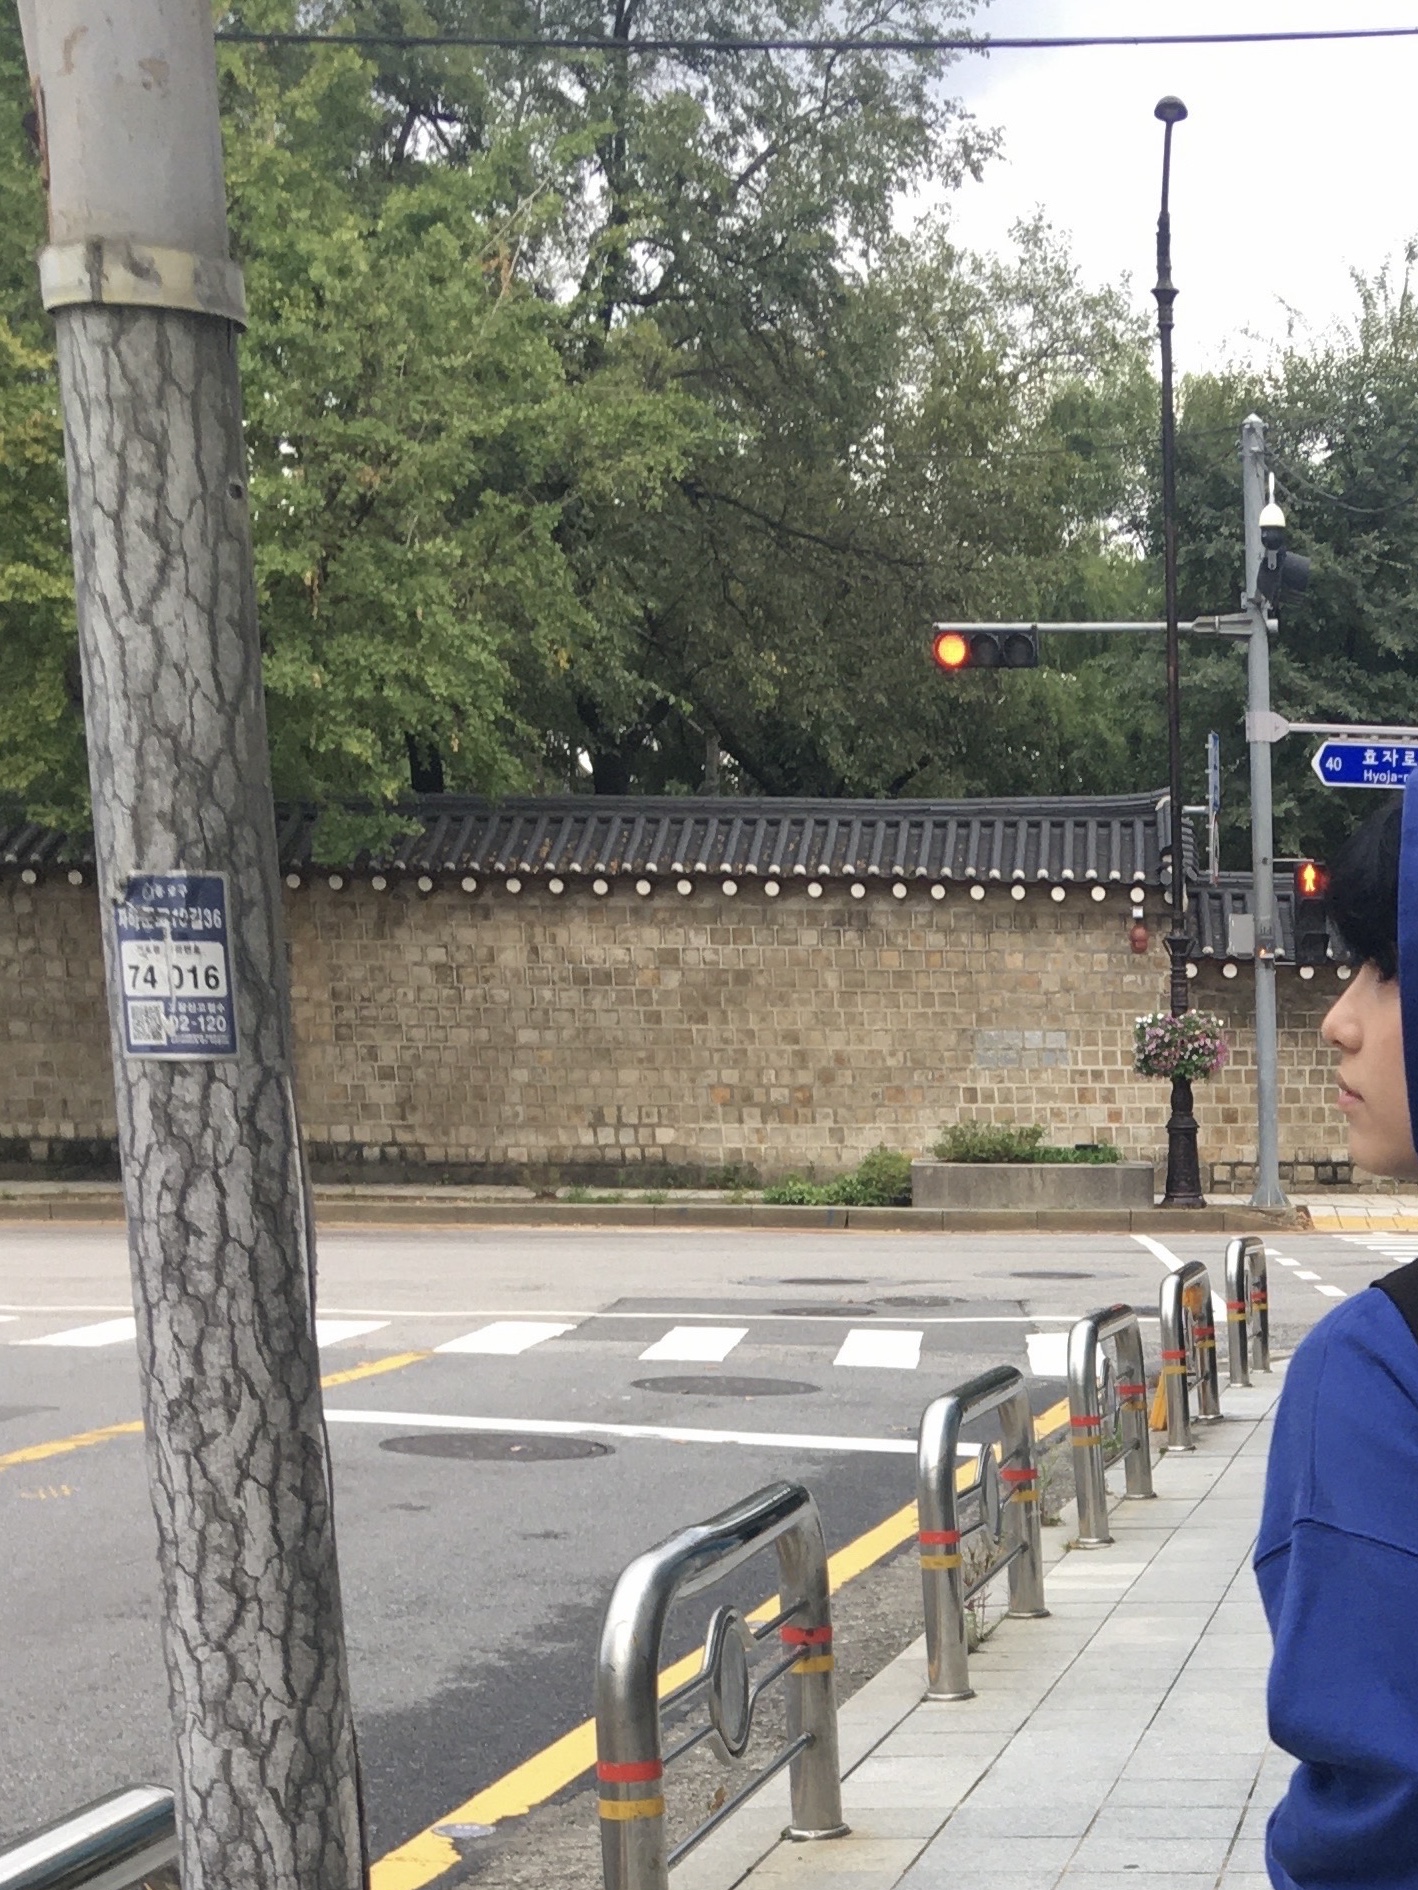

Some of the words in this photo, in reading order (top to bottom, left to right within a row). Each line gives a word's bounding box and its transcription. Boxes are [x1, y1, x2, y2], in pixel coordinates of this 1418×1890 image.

[1325, 757, 1342, 771] 40
[1362, 749, 1418, 767] 효자로
[1363, 769, 1409, 784] Hyoja-r
